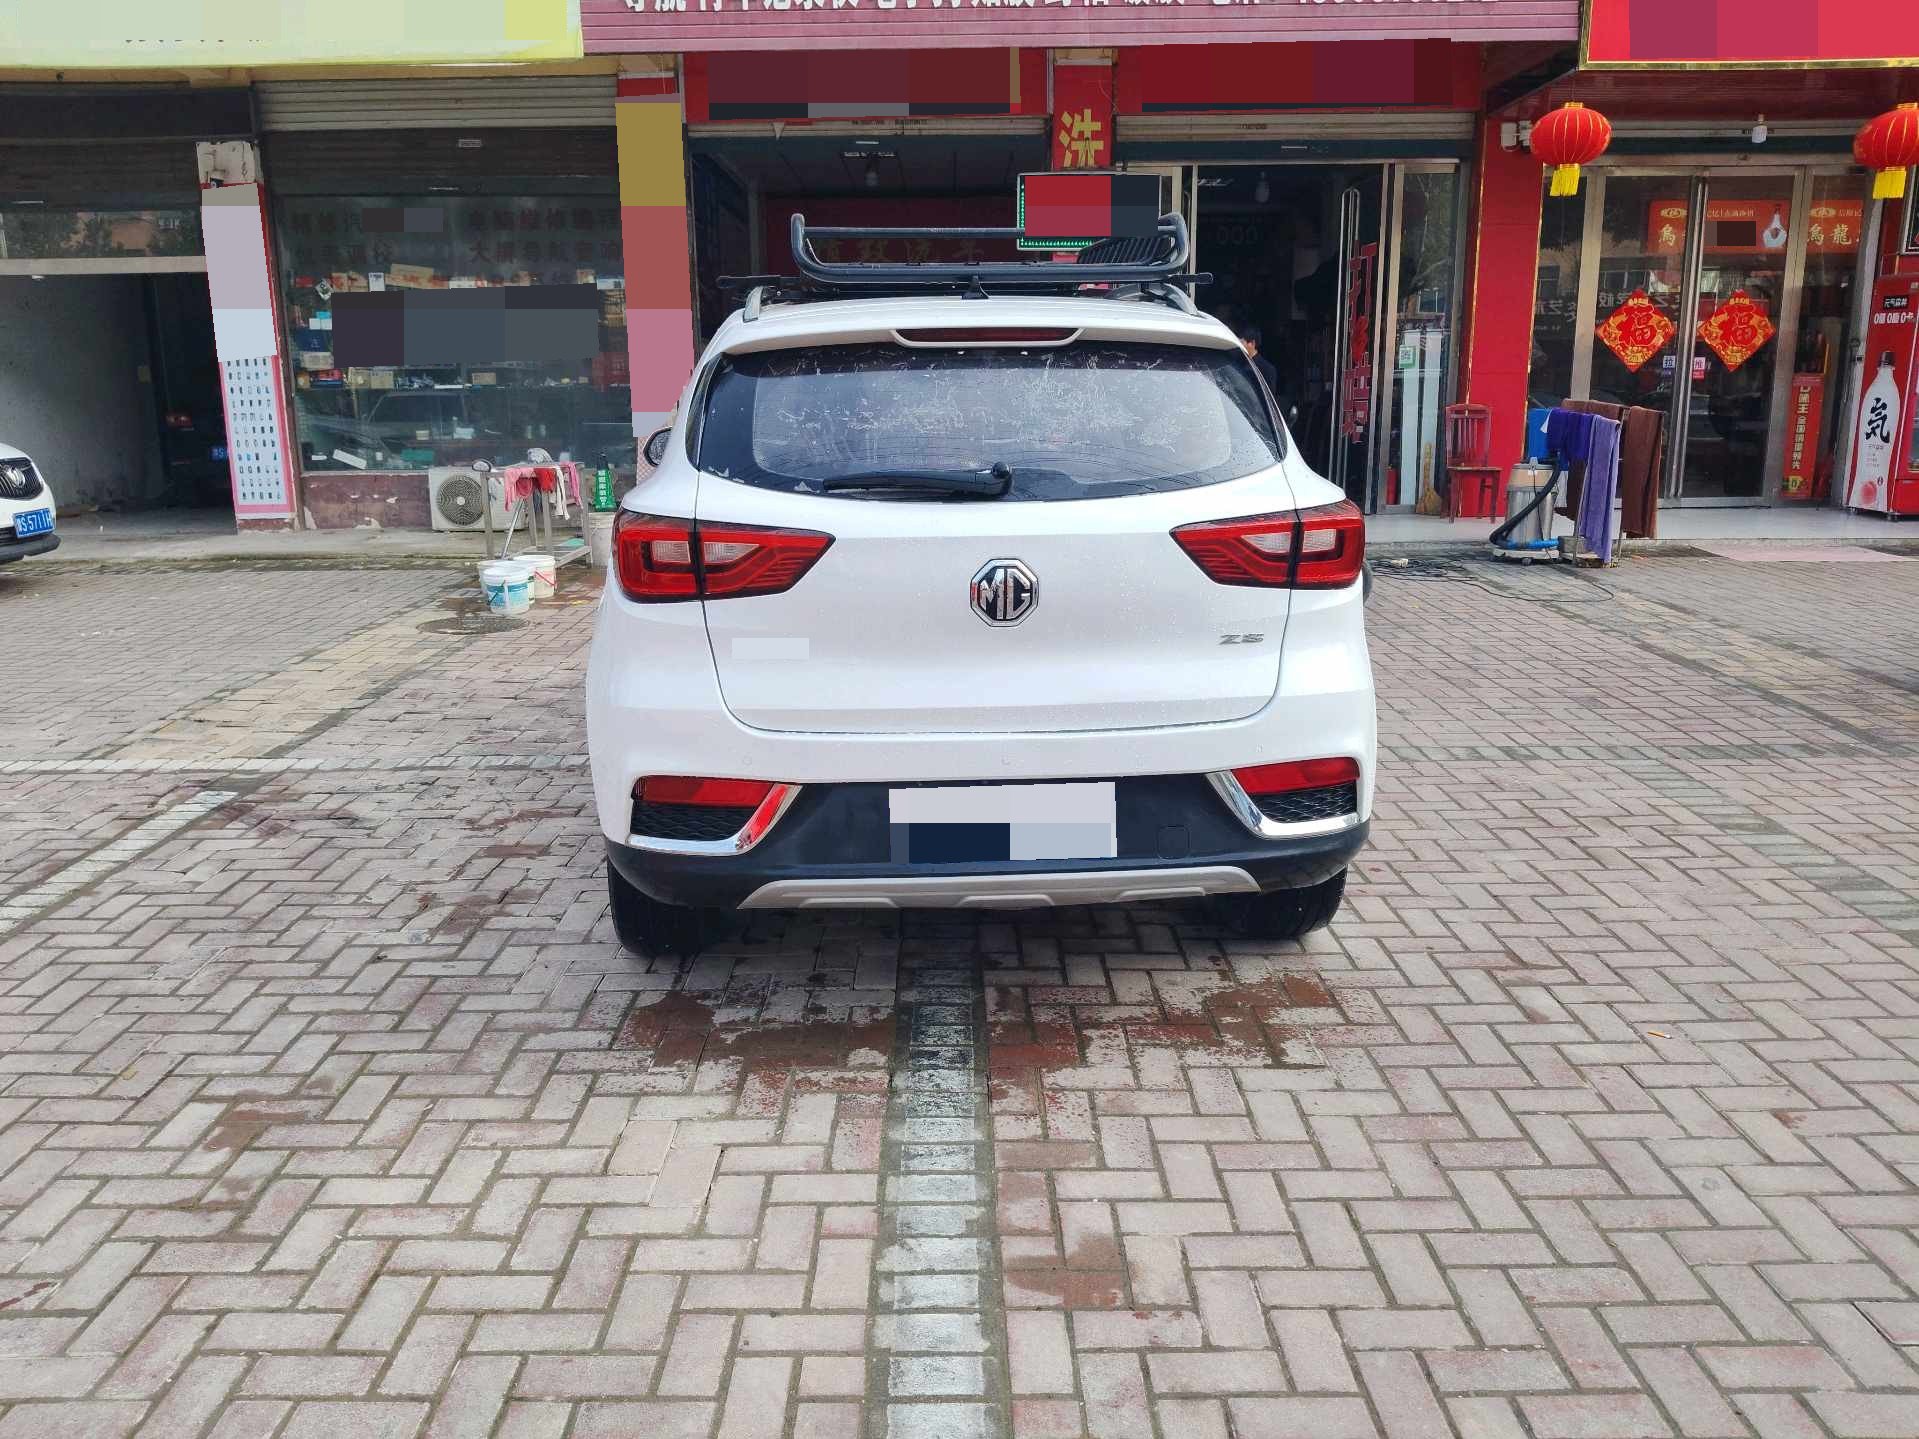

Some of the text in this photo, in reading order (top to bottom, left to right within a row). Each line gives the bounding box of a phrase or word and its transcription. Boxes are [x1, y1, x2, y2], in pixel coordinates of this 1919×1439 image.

[1059, 109, 1104, 168] 洗
[1615, 303, 1658, 348] 福
[1719, 303, 1758, 347] 福
[979, 567, 1032, 620] MG
[1217, 633, 1264, 645] ZS
